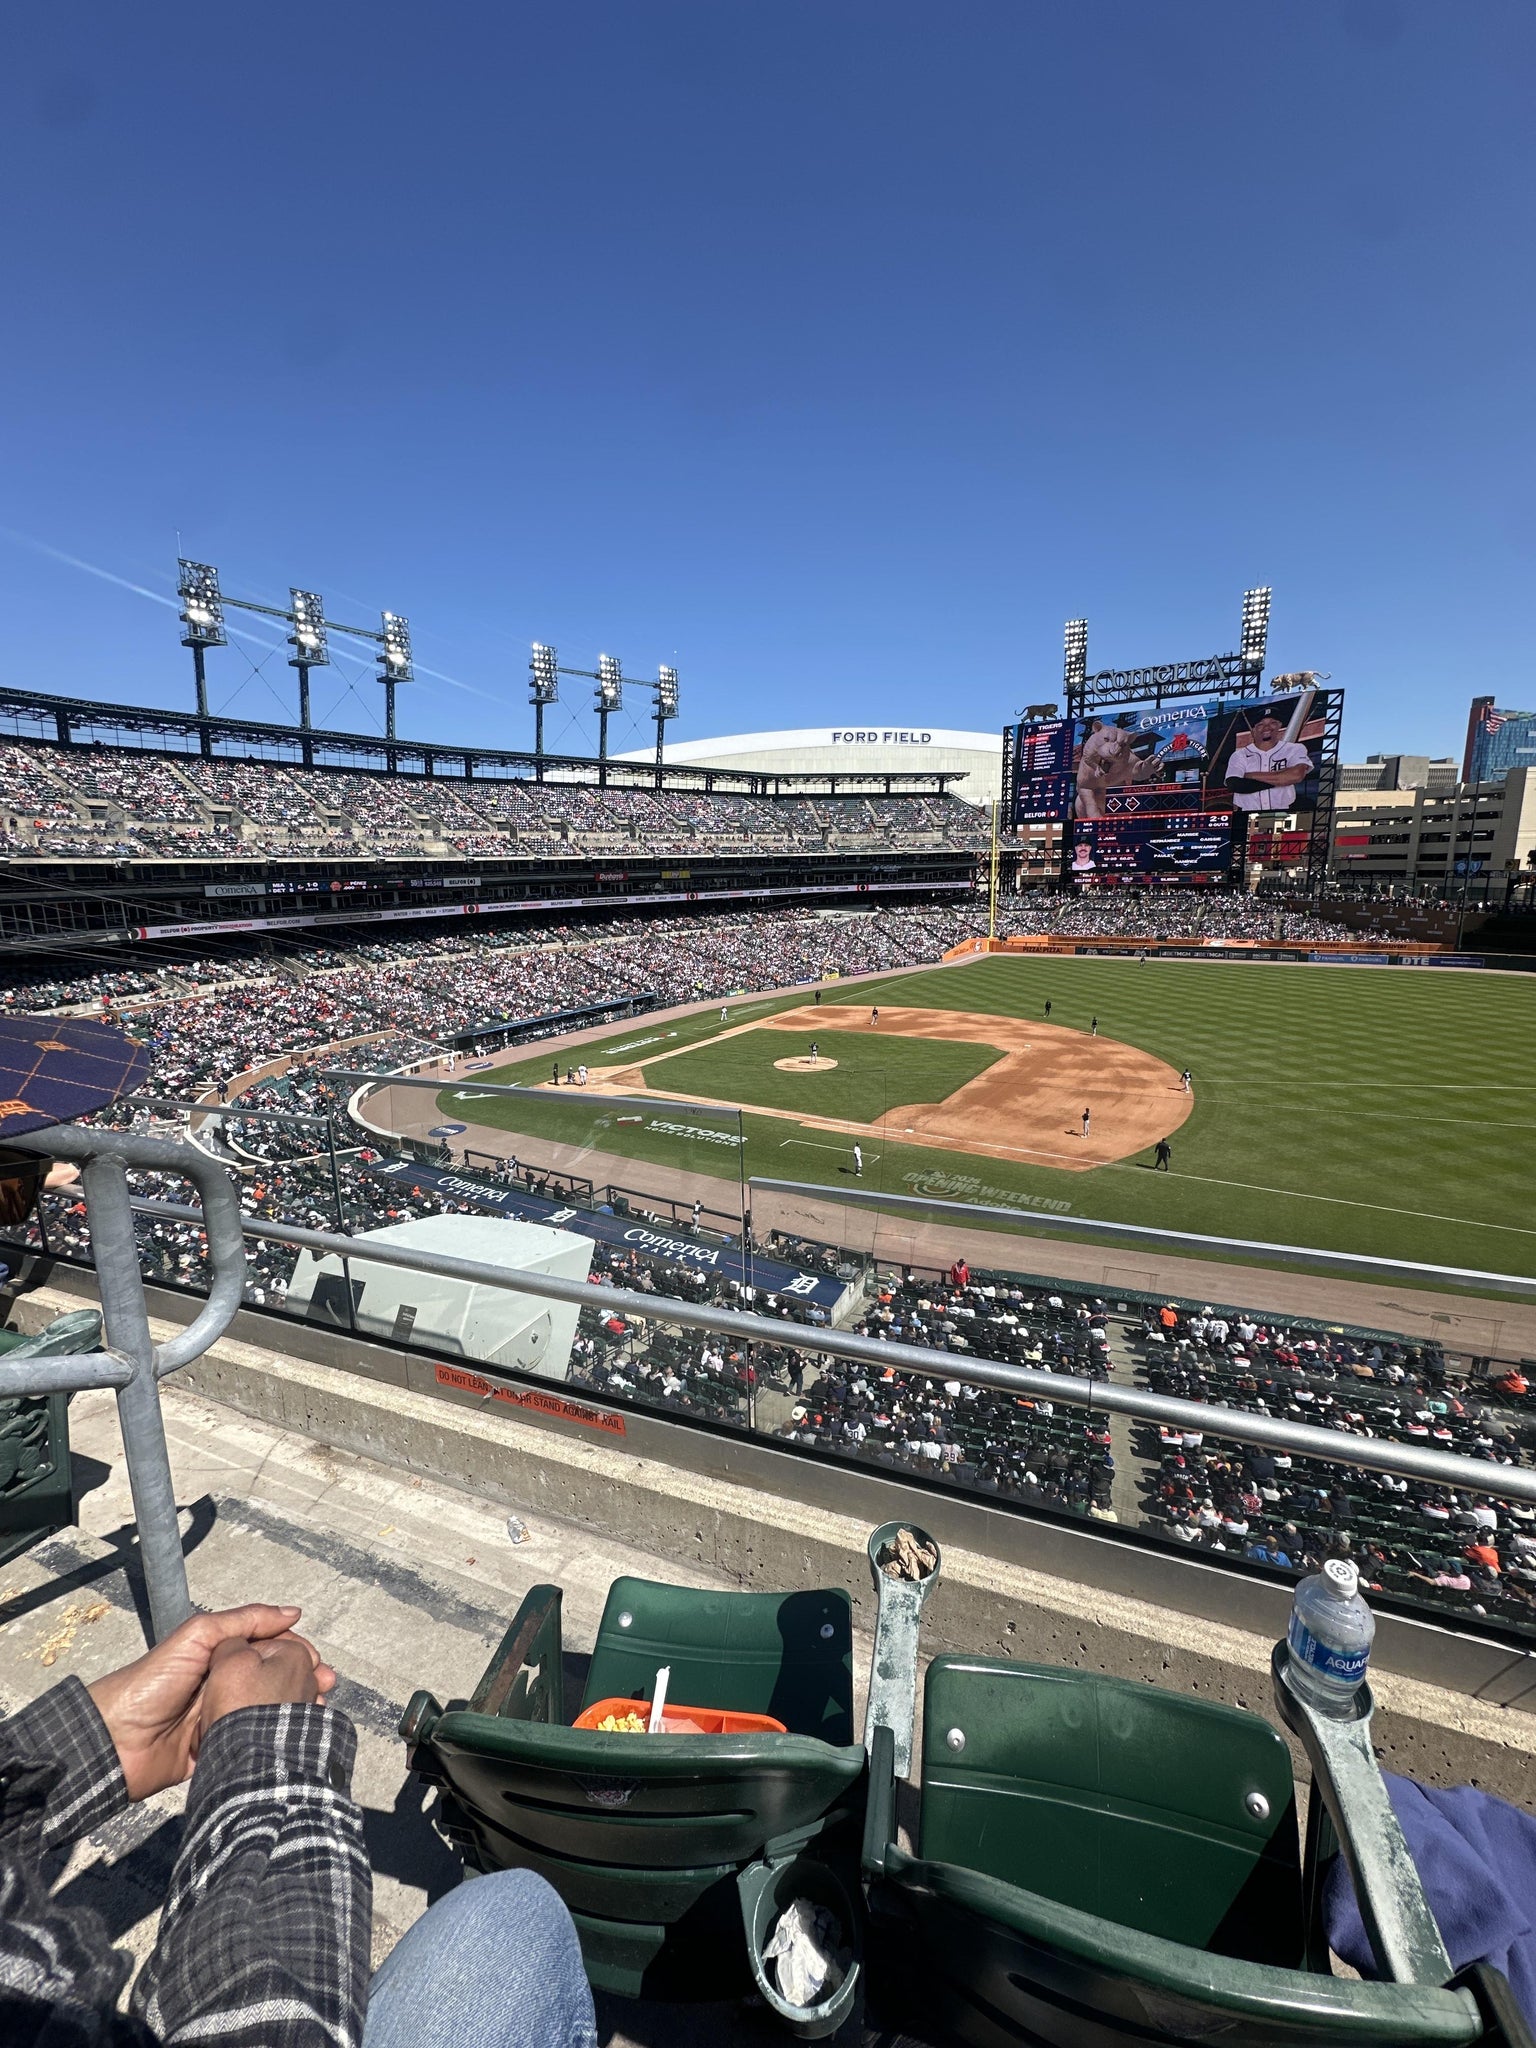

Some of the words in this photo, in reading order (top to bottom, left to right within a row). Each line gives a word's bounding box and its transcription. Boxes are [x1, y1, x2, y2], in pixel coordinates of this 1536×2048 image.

[1126, 682, 1188, 698] PARK
[1158, 722, 1188, 730] PARK
[832, 732, 878, 744] FORD
[882, 732, 932, 744] FIELD
[1190, 741, 1208, 758] TIGERS
[644, 1126, 674, 1134] HOME
[676, 1132, 738, 1147] SOLUTIONS
[650, 1120, 748, 1143] VICTORS
[950, 1174, 981, 1184] 2026
[446, 1187, 482, 1200] PARK
[902, 1172, 981, 1194] OPENING
[978, 1186, 1072, 1212] WEEKEND
[640, 1243, 686, 1260] PARK
[439, 1369, 450, 1380] DO
[452, 1372, 466, 1385] NOT
[468, 1375, 489, 1390] LEAN
[534, 1396, 560, 1413] STAND
[563, 1402, 600, 1423] AGAINST
[602, 1414, 621, 1430] RAIL
[848, 1430, 858, 1440] 30
[944, 1452, 956, 1461] 29
